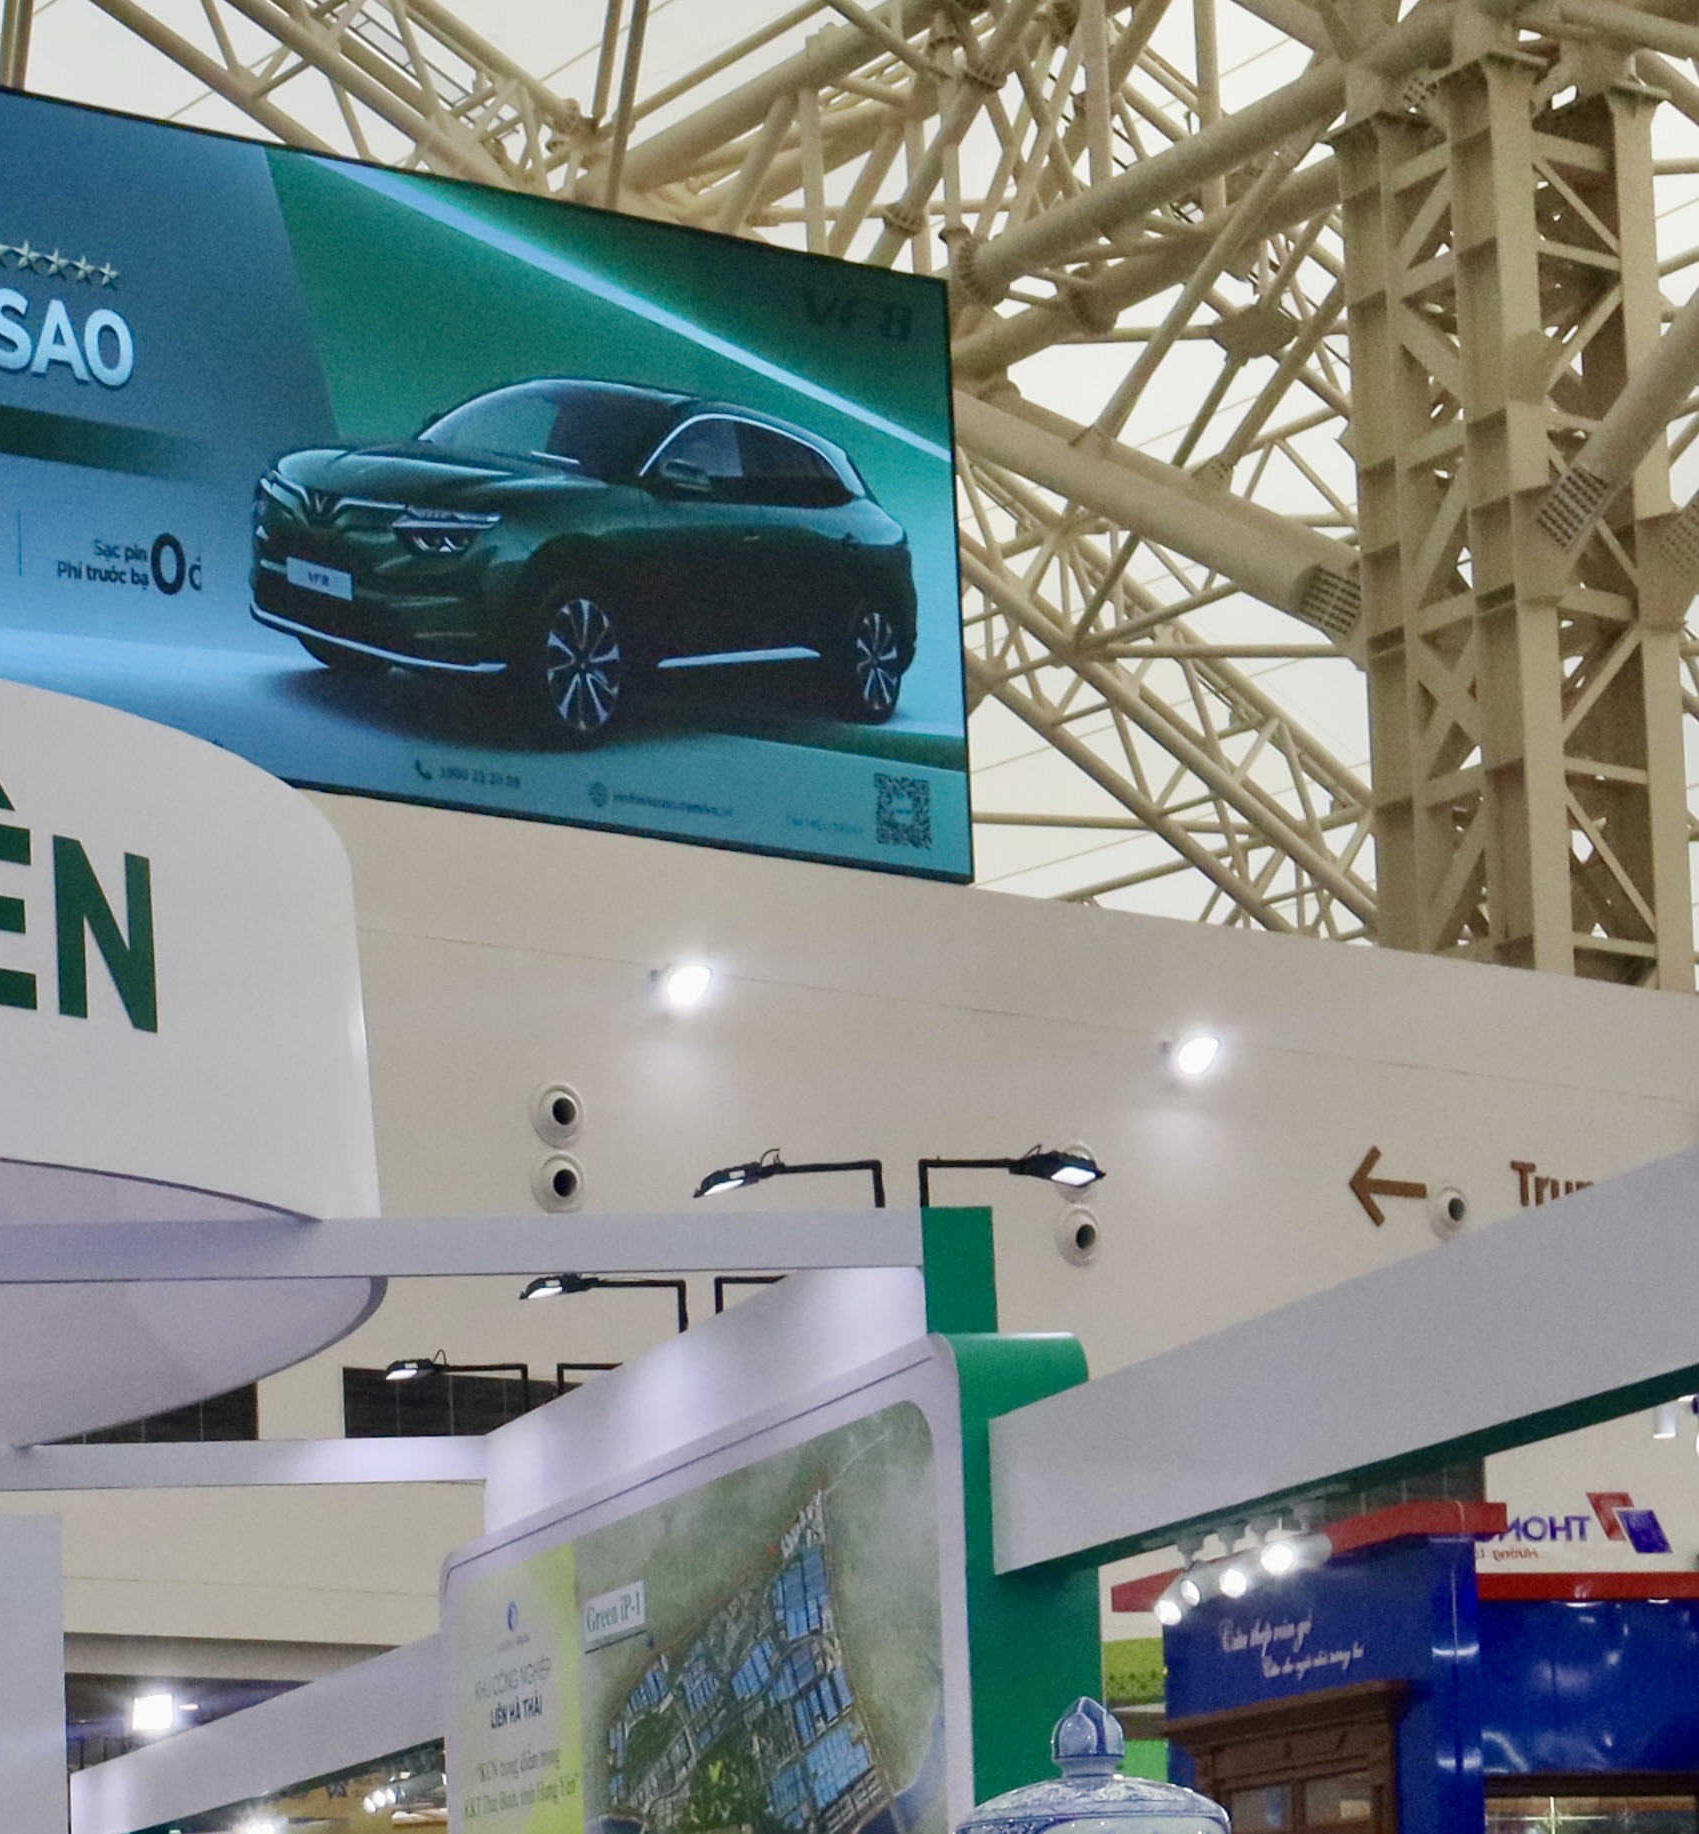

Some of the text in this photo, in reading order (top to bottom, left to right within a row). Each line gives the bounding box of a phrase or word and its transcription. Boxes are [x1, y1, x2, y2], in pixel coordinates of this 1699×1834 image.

[94, 539, 120, 561] Sạc
[57, 561, 82, 581] Phí
[131, 567, 149, 590] bạ
[1510, 1160, 1594, 1206] Tru
[586, 1605, 617, 1632] Green
[490, 1690, 543, 1729] LIÊN HÀ THÁI
